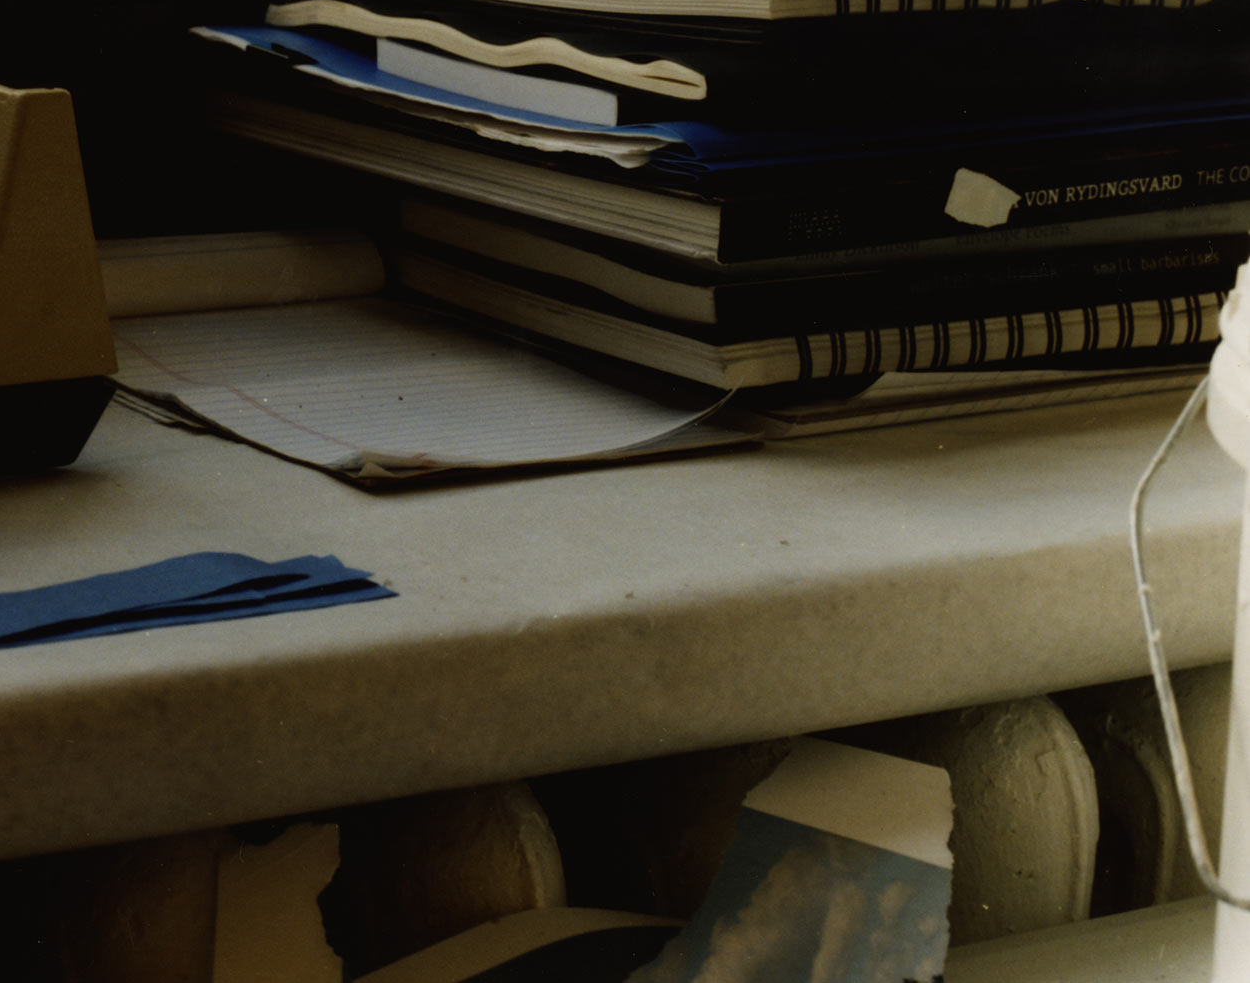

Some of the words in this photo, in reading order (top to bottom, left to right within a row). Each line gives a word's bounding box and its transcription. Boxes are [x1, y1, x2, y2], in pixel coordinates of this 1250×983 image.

[1024, 188, 1061, 208] VON
[1065, 173, 1184, 203] RYDINGSVARD
[1197, 167, 1226, 185] THE
[1093, 257, 1134, 276] small
[1140, 250, 1221, 272] barbarisms
